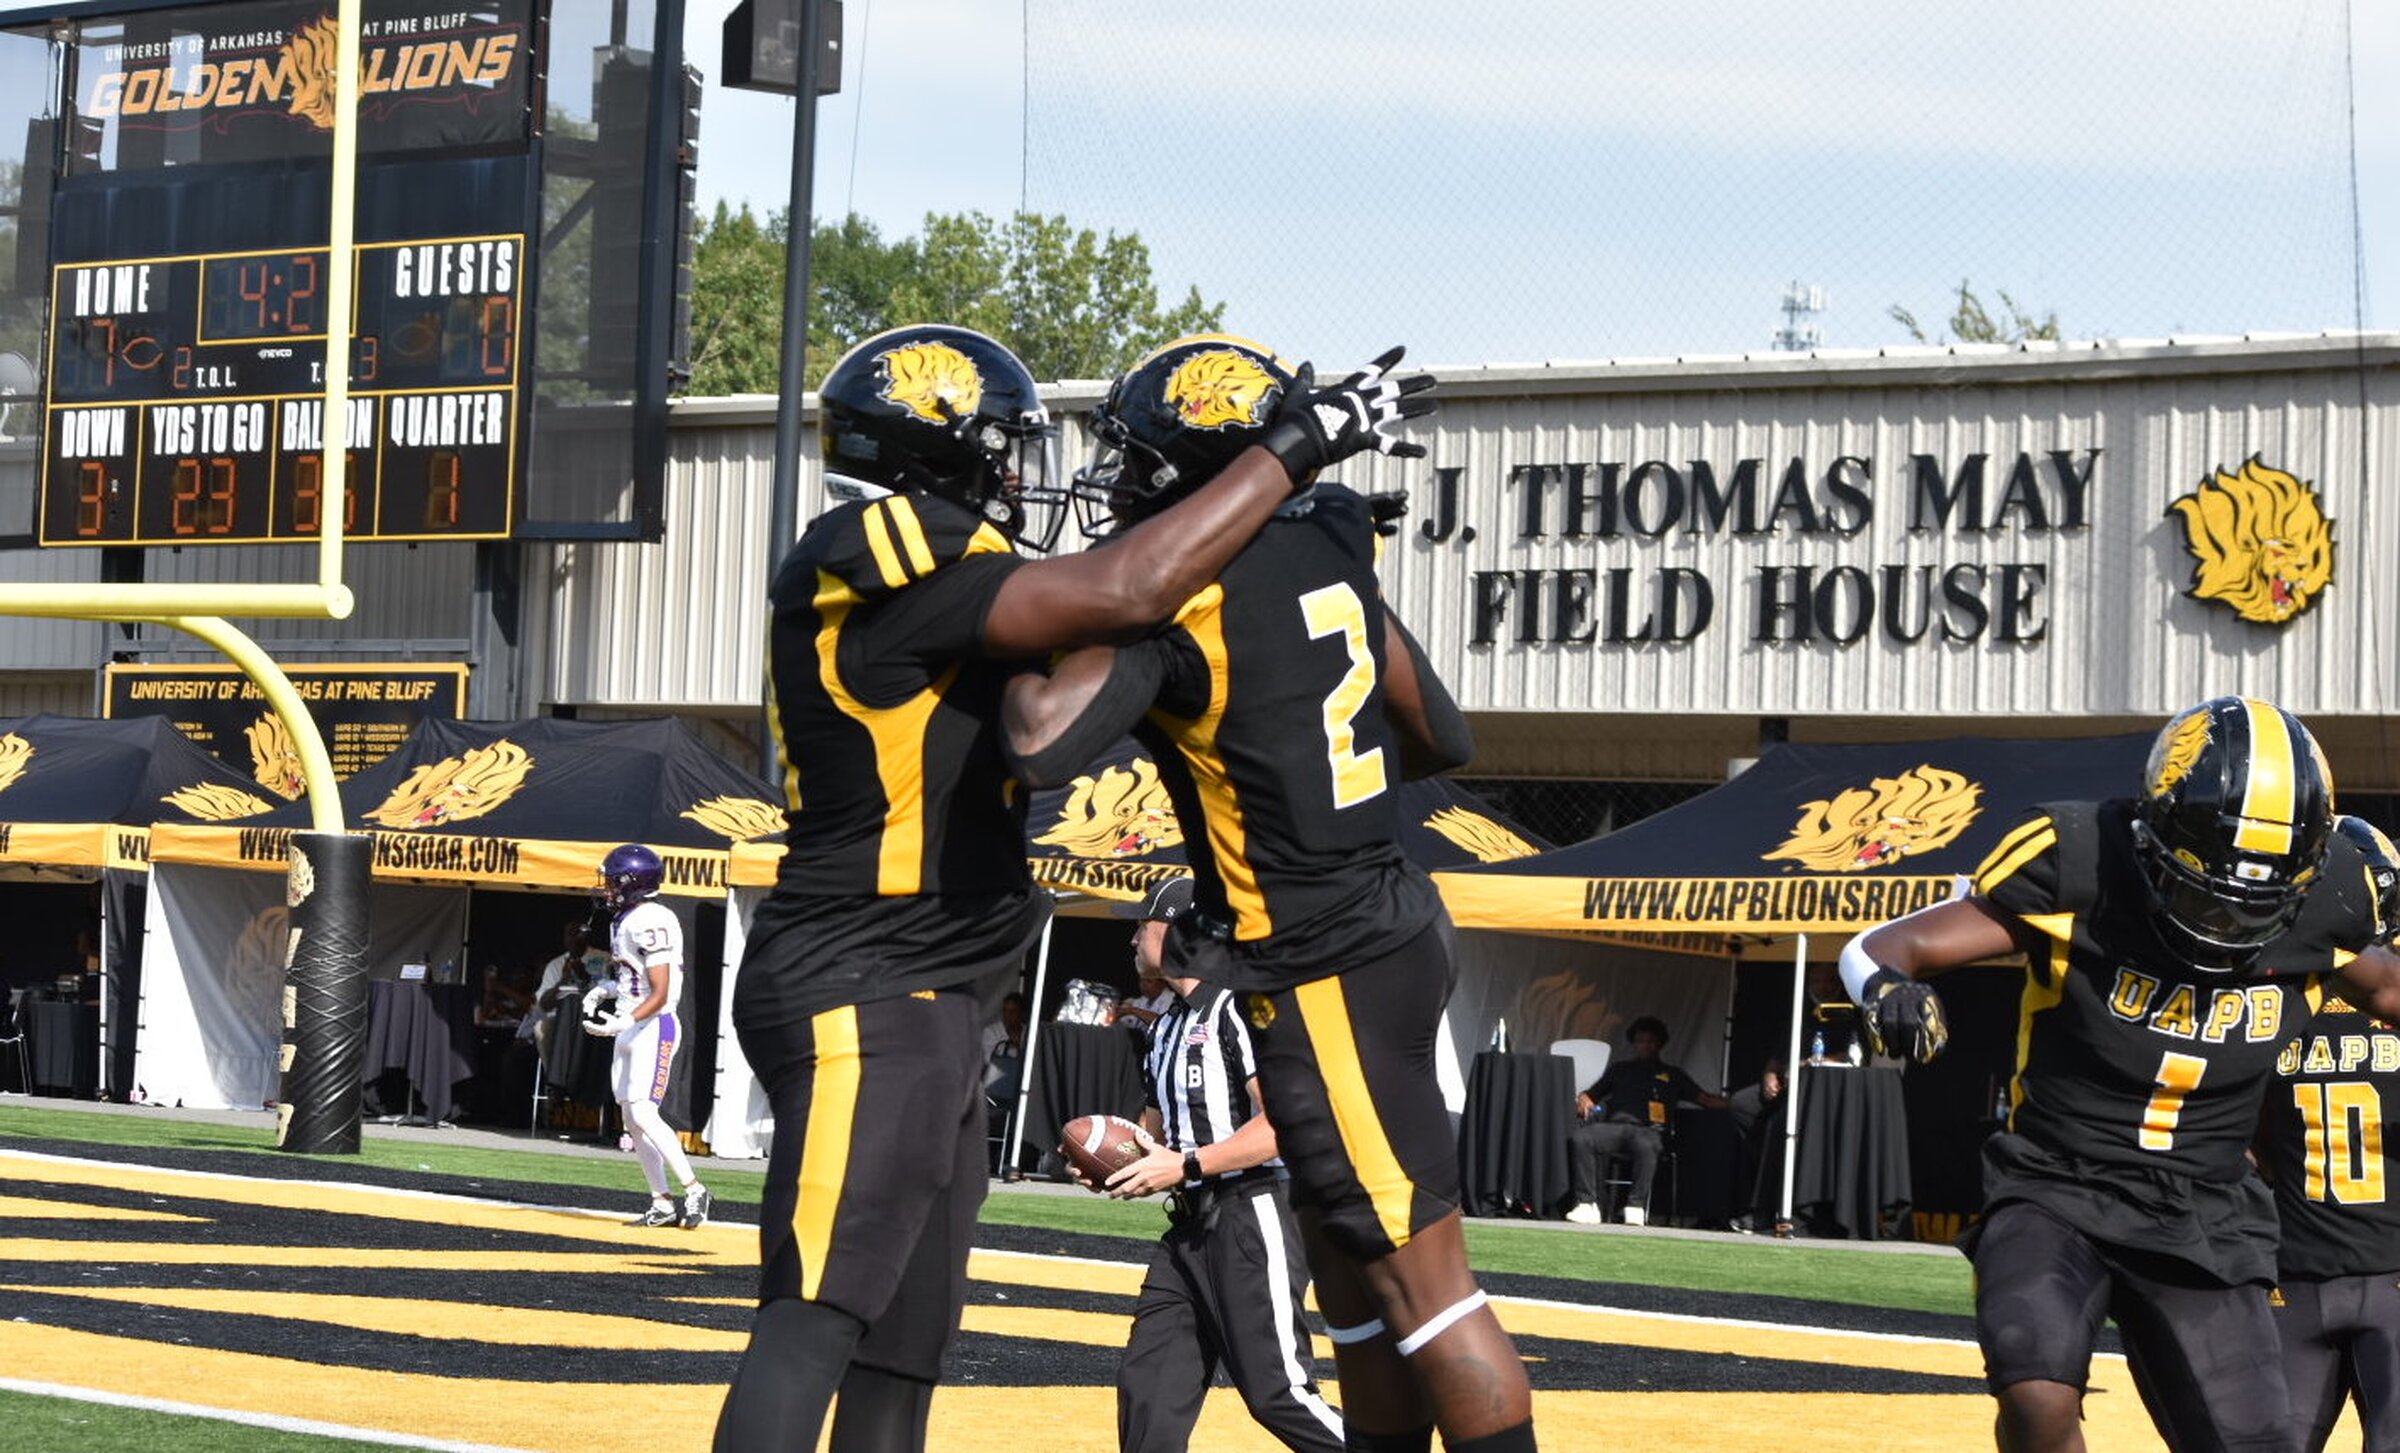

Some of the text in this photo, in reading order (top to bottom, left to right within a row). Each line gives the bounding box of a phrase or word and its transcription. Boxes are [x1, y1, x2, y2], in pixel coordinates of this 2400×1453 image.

[105, 30, 283, 62] UNIVERSITY OF ARKANSAS
[362, 13, 467, 37] AT PINE BLUFF
[90, 58, 292, 117] GOLDEN
[364, 33, 518, 93] LIONS
[75, 265, 151, 317] HOME
[396, 241, 513, 298] GUESTS
[359, 336, 379, 380] 3
[481, 296, 513, 375] 0
[173, 346, 192, 389] 2
[61, 408, 126, 458] DOWN
[152, 403, 265, 456] YDS TO GO
[282, 400, 324, 451] BAL
[390, 393, 503, 447] QUARTER
[77, 461, 105, 536] 3
[172, 456, 237, 535] 23
[1422, 449, 2105, 543] J. THOMAS MAY
[1469, 563, 2049, 648] FIELD HOUSE
[130, 680, 217, 700] UNIVERSITY
[217, 680, 239, 700] OF
[324, 680, 349, 700] AT
[346, 680, 383, 700] PINE
[385, 680, 437, 700] BLUFF
[1299, 581, 1387, 810] 2
[645, 927, 669, 947] 37
[2107, 965, 2284, 1044] UAPB
[1187, 1064, 1202, 1088] B
[2293, 1082, 2386, 1205] 10
